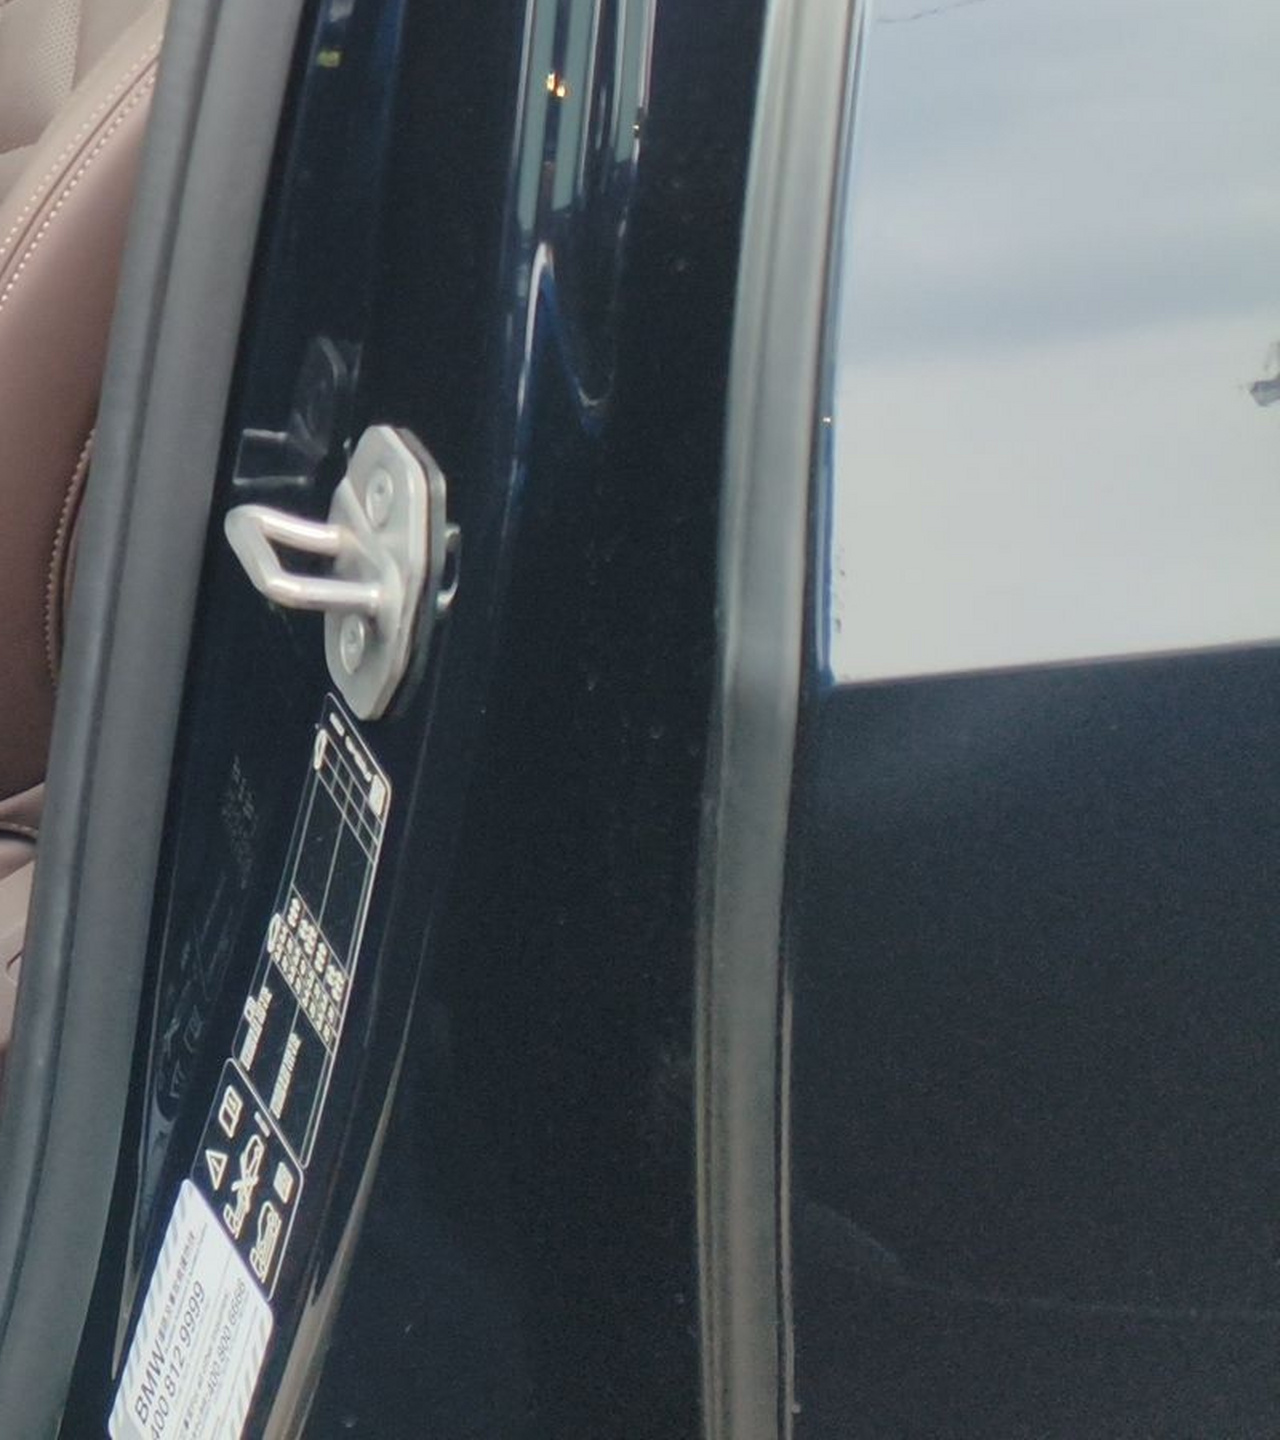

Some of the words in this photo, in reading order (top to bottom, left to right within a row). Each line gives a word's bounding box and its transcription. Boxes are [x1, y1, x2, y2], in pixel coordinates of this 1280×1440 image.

[134, 1340, 167, 1426] BMW
[164, 1345, 186, 1398] 812
[179, 1280, 206, 1348] 9999
